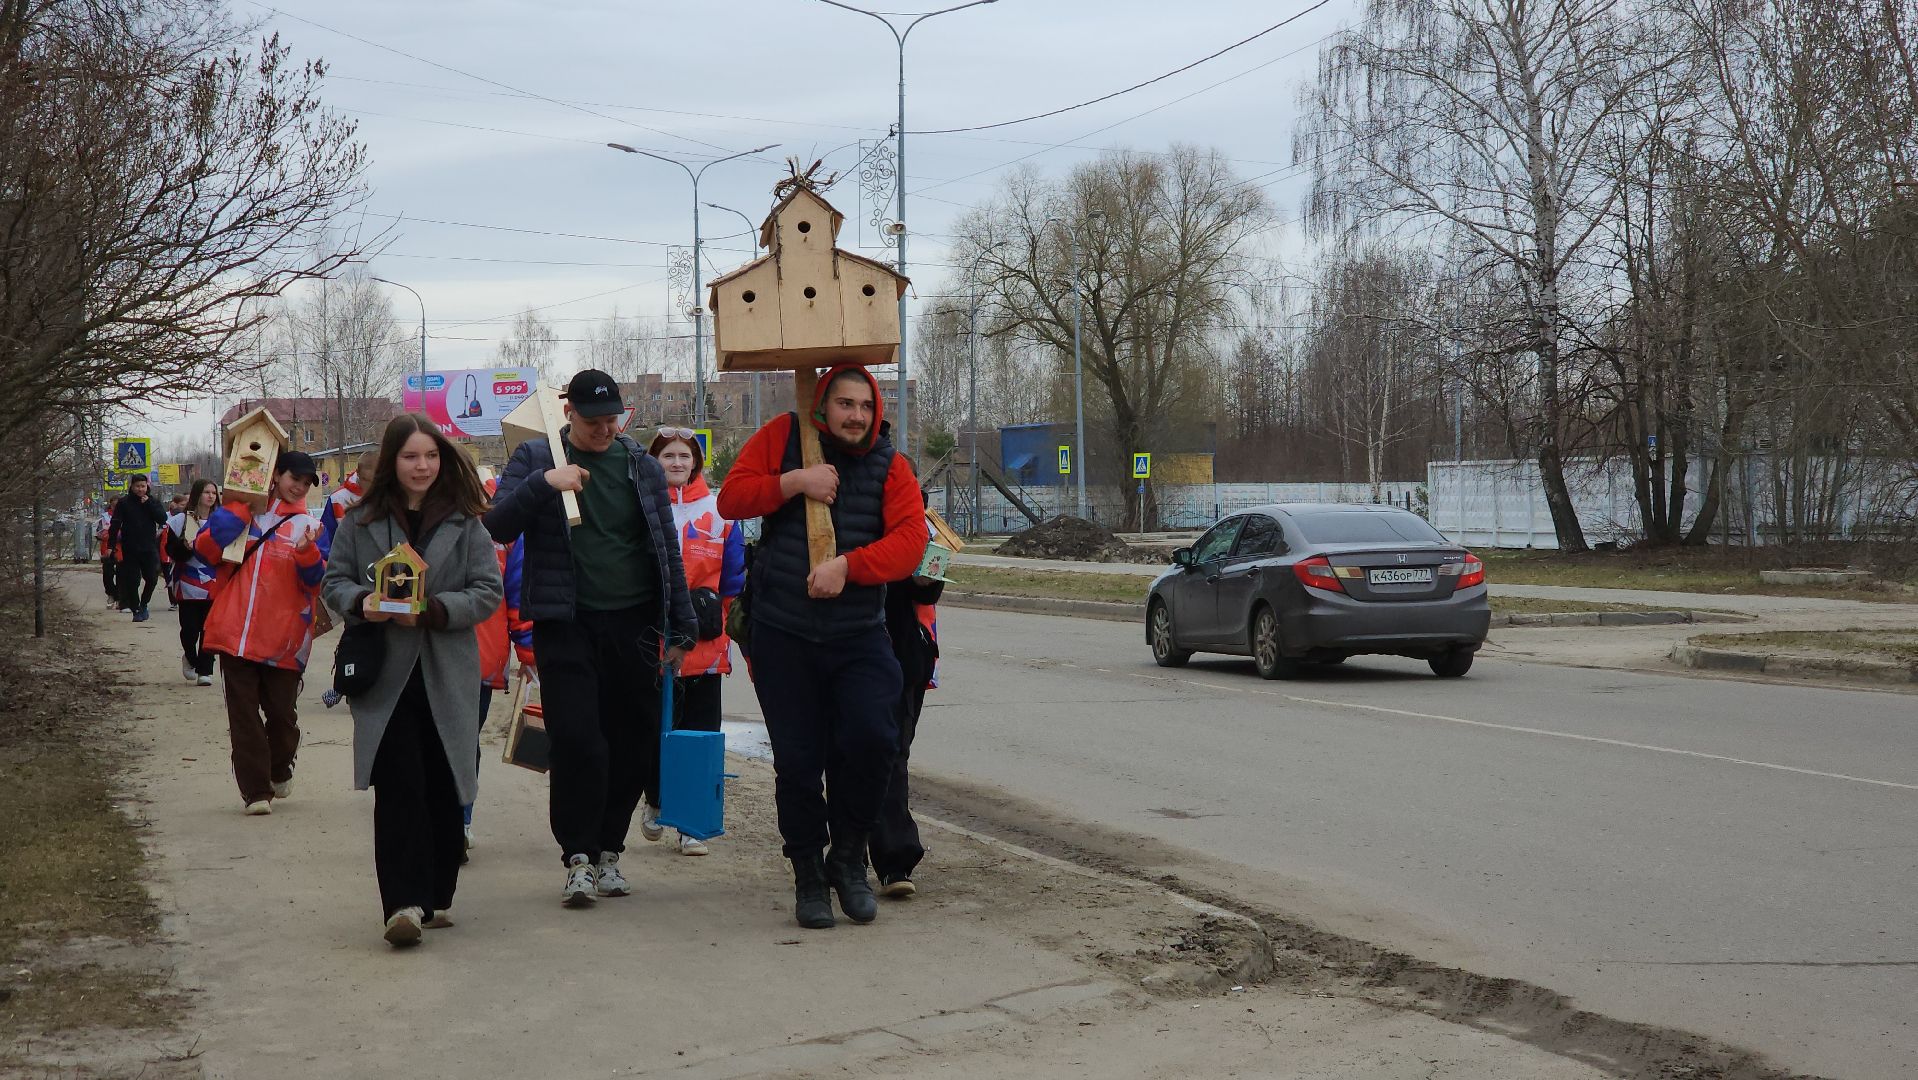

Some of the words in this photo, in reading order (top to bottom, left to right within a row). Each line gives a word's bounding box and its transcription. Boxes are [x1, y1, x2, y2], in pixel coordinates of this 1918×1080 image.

[496, 385, 503, 394] 5
[505, 385, 523, 394] 999
[1413, 569, 1428, 578] 777
